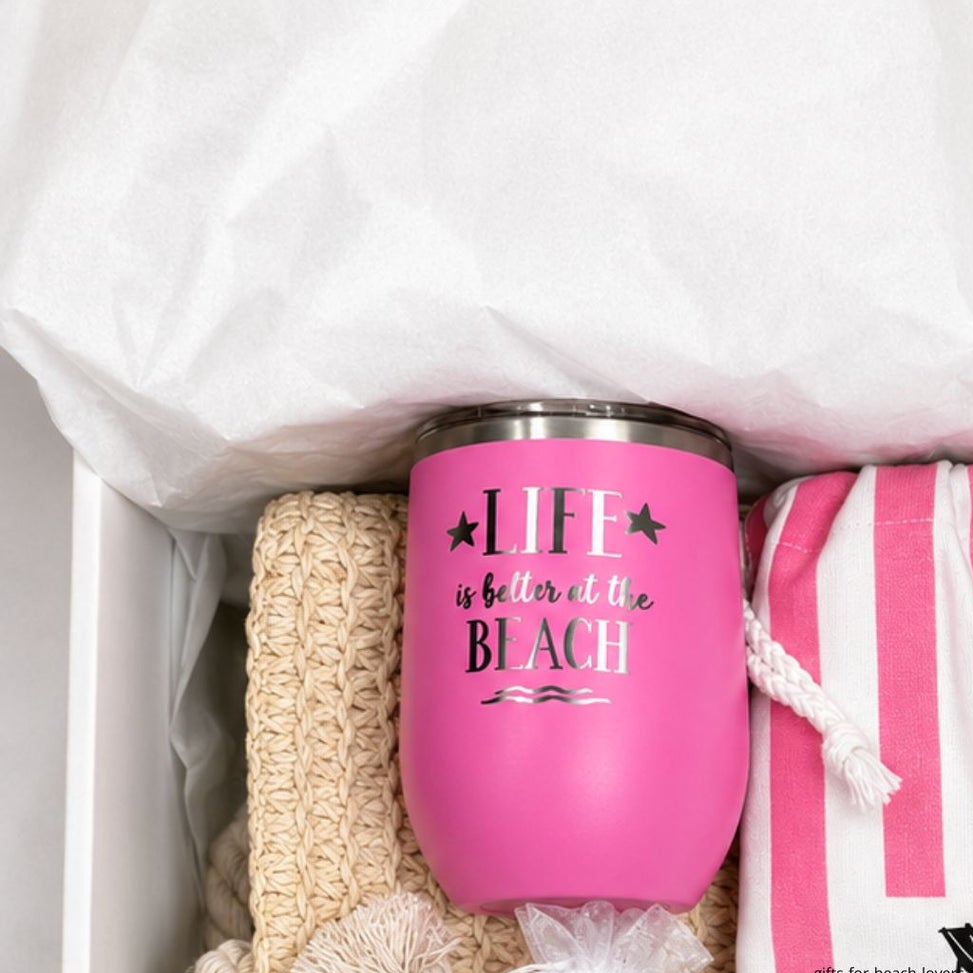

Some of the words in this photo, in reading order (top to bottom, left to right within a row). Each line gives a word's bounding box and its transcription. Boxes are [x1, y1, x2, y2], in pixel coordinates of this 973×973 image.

[482, 486, 623, 558] LIFE
[456, 583, 476, 609] is
[482, 572, 562, 609] better
[567, 573, 599, 607] at
[607, 573, 654, 611] the
[465, 616, 632, 675] BEACH
